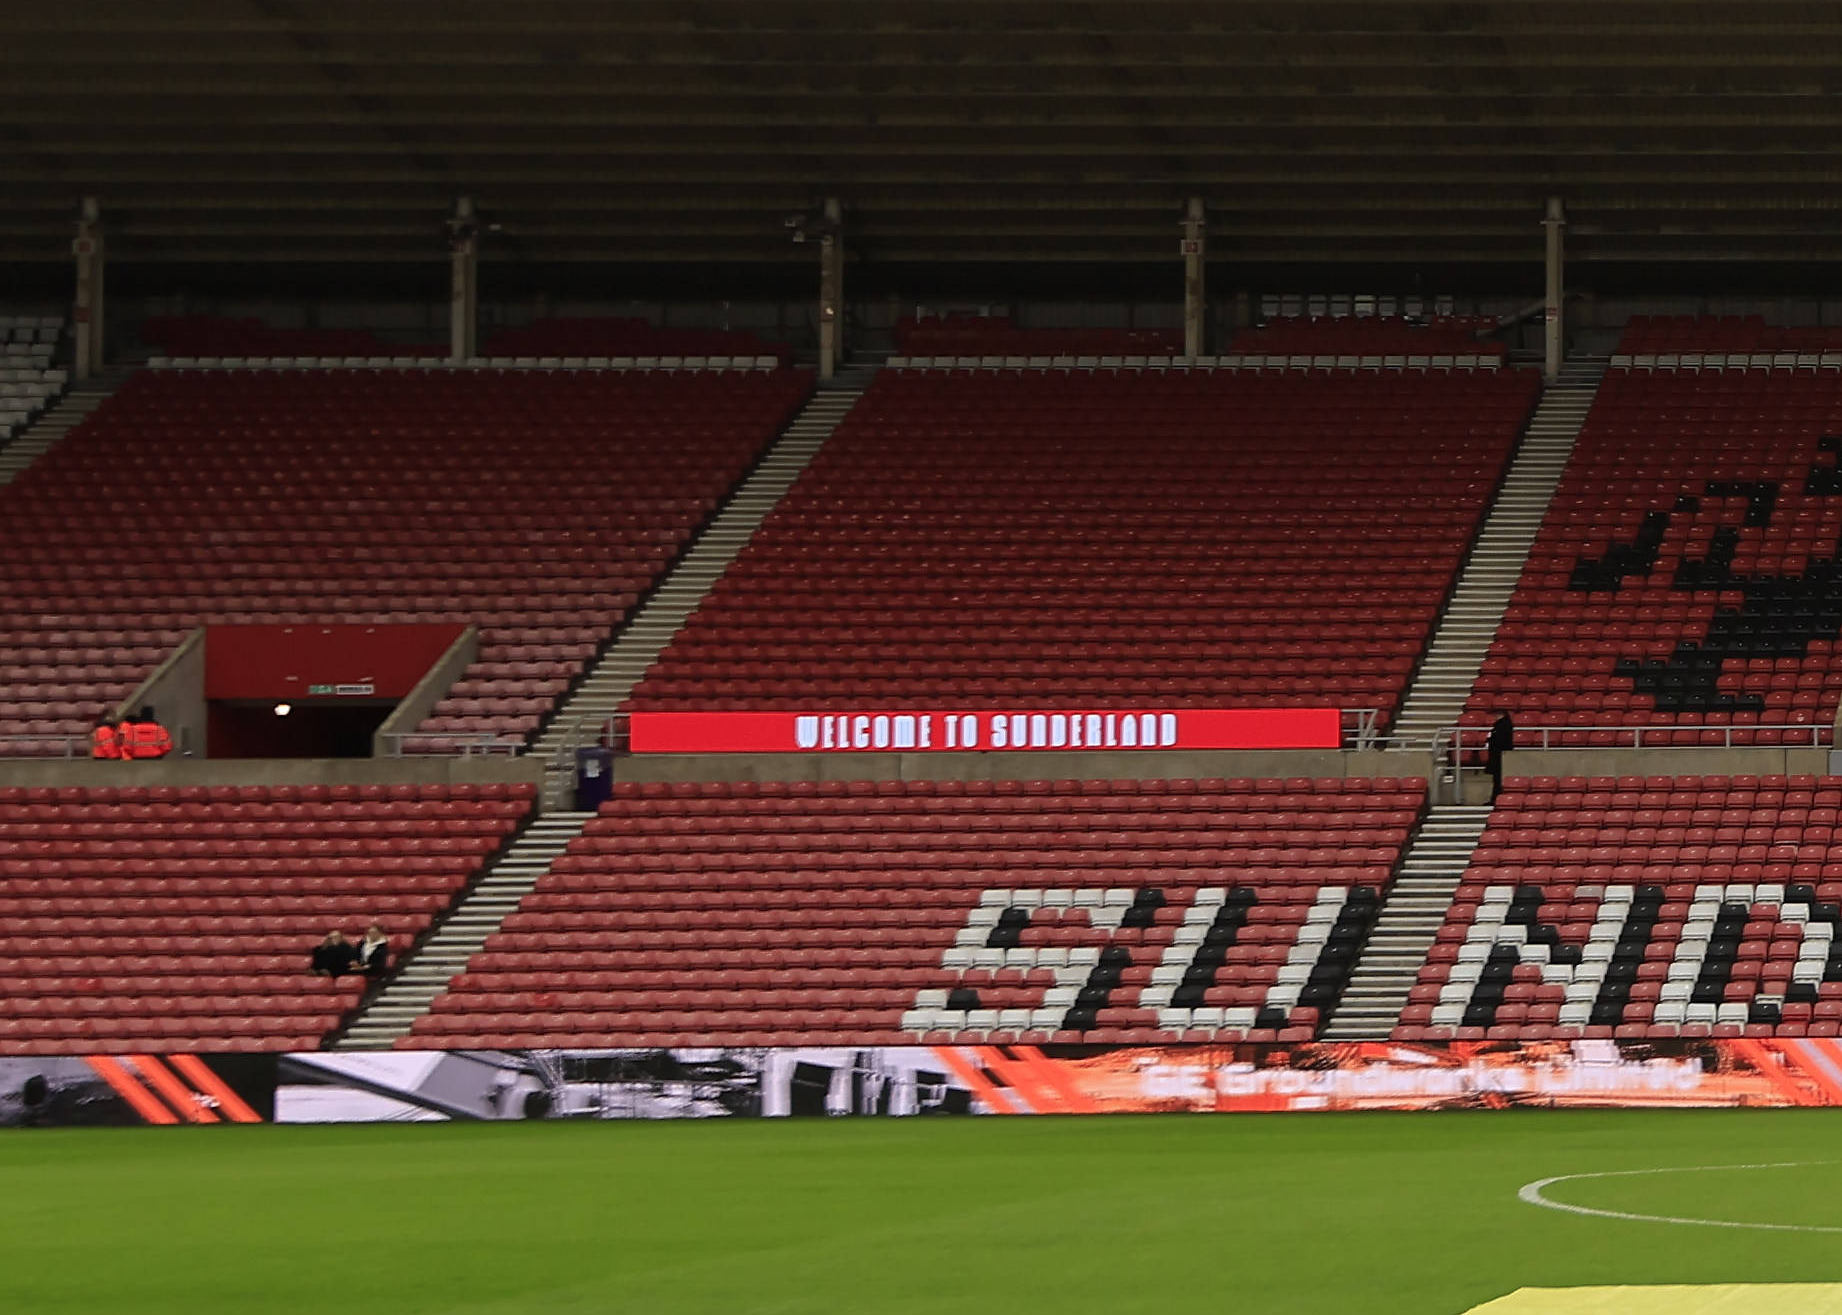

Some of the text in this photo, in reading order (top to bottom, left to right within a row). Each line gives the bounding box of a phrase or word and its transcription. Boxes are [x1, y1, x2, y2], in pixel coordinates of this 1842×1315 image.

[795, 712, 1178, 749] WELCOME TO SUNDERLAND
